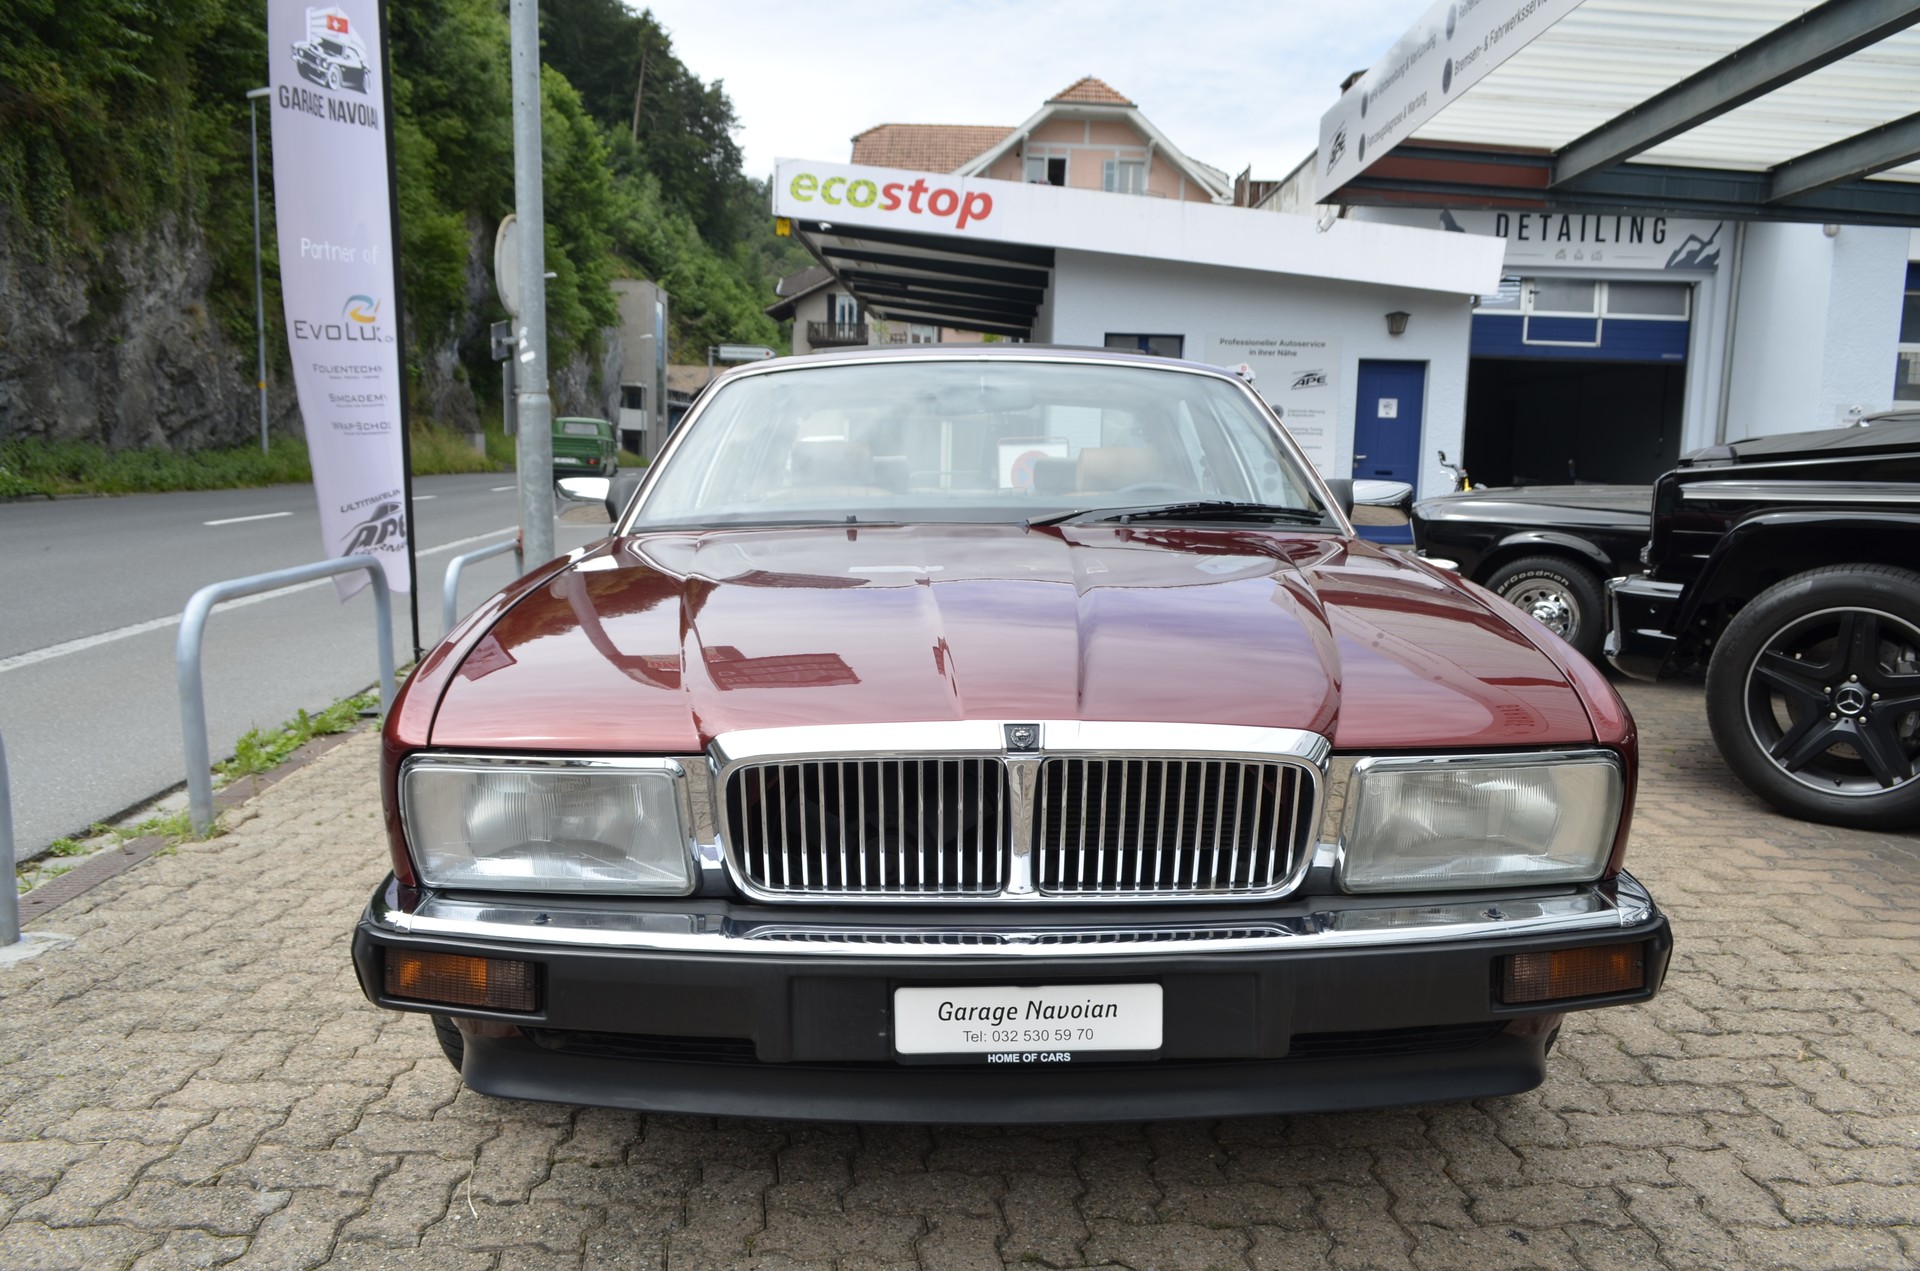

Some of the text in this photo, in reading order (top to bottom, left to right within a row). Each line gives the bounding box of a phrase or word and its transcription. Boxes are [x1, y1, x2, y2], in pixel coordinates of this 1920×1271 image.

[279, 84, 325, 119] GARAGE
[790, 172, 993, 230] ecostop
[1495, 213, 1667, 244] DETAILING
[300, 237, 380, 265] Partner of
[1219, 338, 1326, 348] Professioneller Autoservice
[1249, 348, 1256, 356] in
[1497, 570, 1569, 594] BFGoodrich
[937, 999, 1118, 1027] Garage Navoian
[962, 1028, 1094, 1043] Tel: 032 530 59 70
[987, 1052, 1071, 1063] HOME OF CARS
